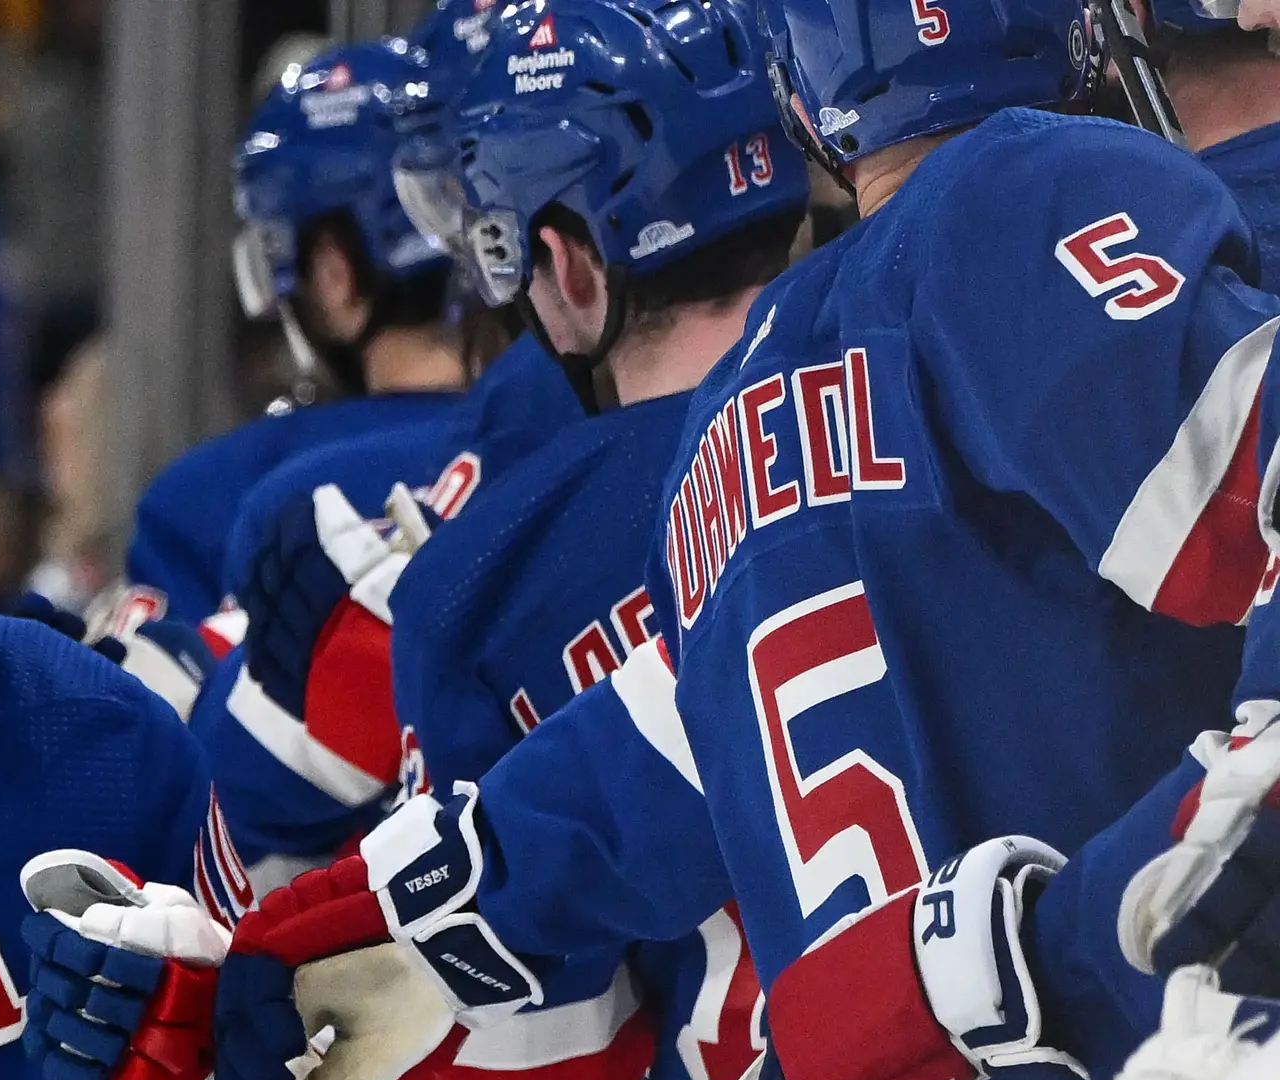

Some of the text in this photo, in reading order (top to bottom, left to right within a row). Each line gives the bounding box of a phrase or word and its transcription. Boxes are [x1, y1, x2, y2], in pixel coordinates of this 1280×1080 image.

[507, 48, 575, 75] Benjamin
[515, 72, 565, 95] Moore
[725, 134, 773, 196] 13
[1054, 211, 1186, 320] 5
[746, 580, 928, 920] 5
